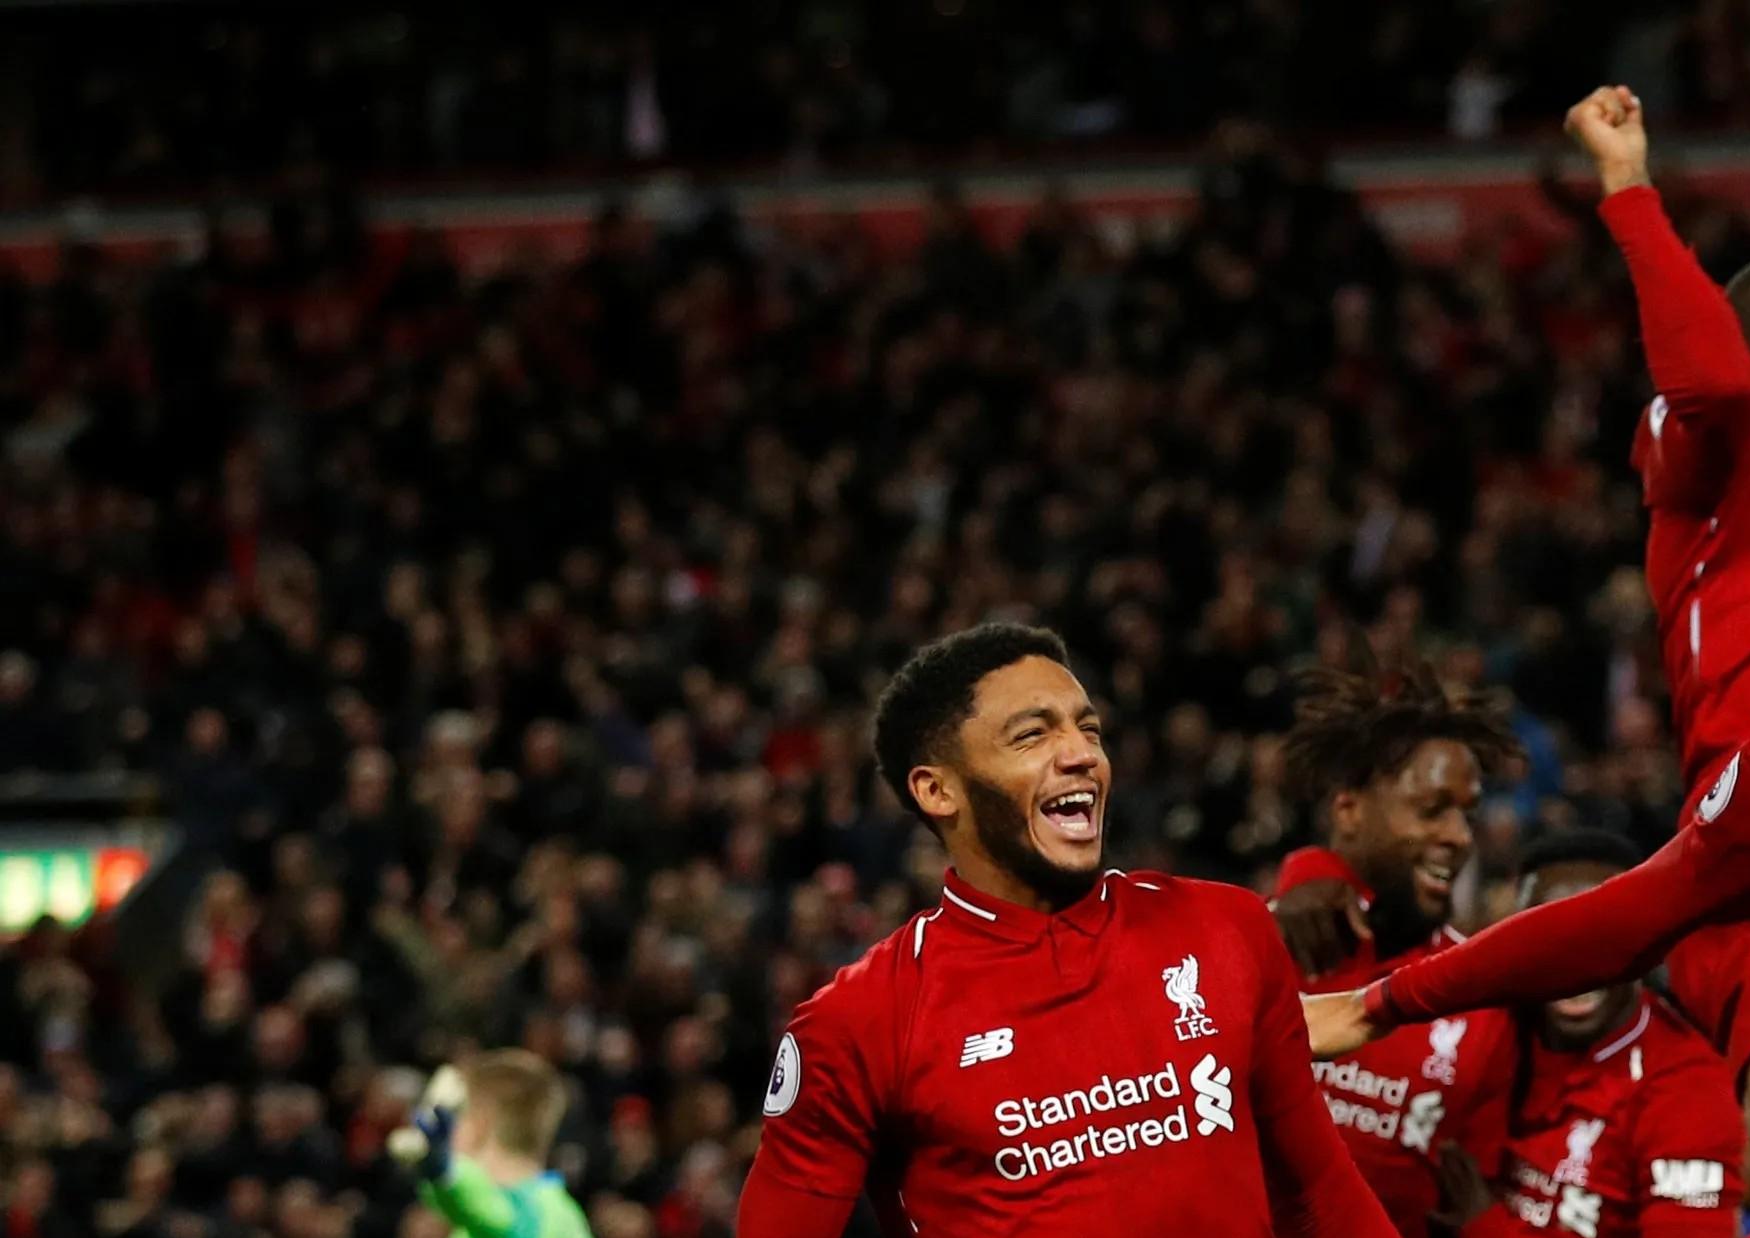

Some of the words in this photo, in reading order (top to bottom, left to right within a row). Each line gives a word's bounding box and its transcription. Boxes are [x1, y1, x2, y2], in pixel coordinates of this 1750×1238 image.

[959, 1027, 1015, 1068] NB
[994, 1062, 1181, 1136] Standard
[994, 1105, 1190, 1181] Chartered
